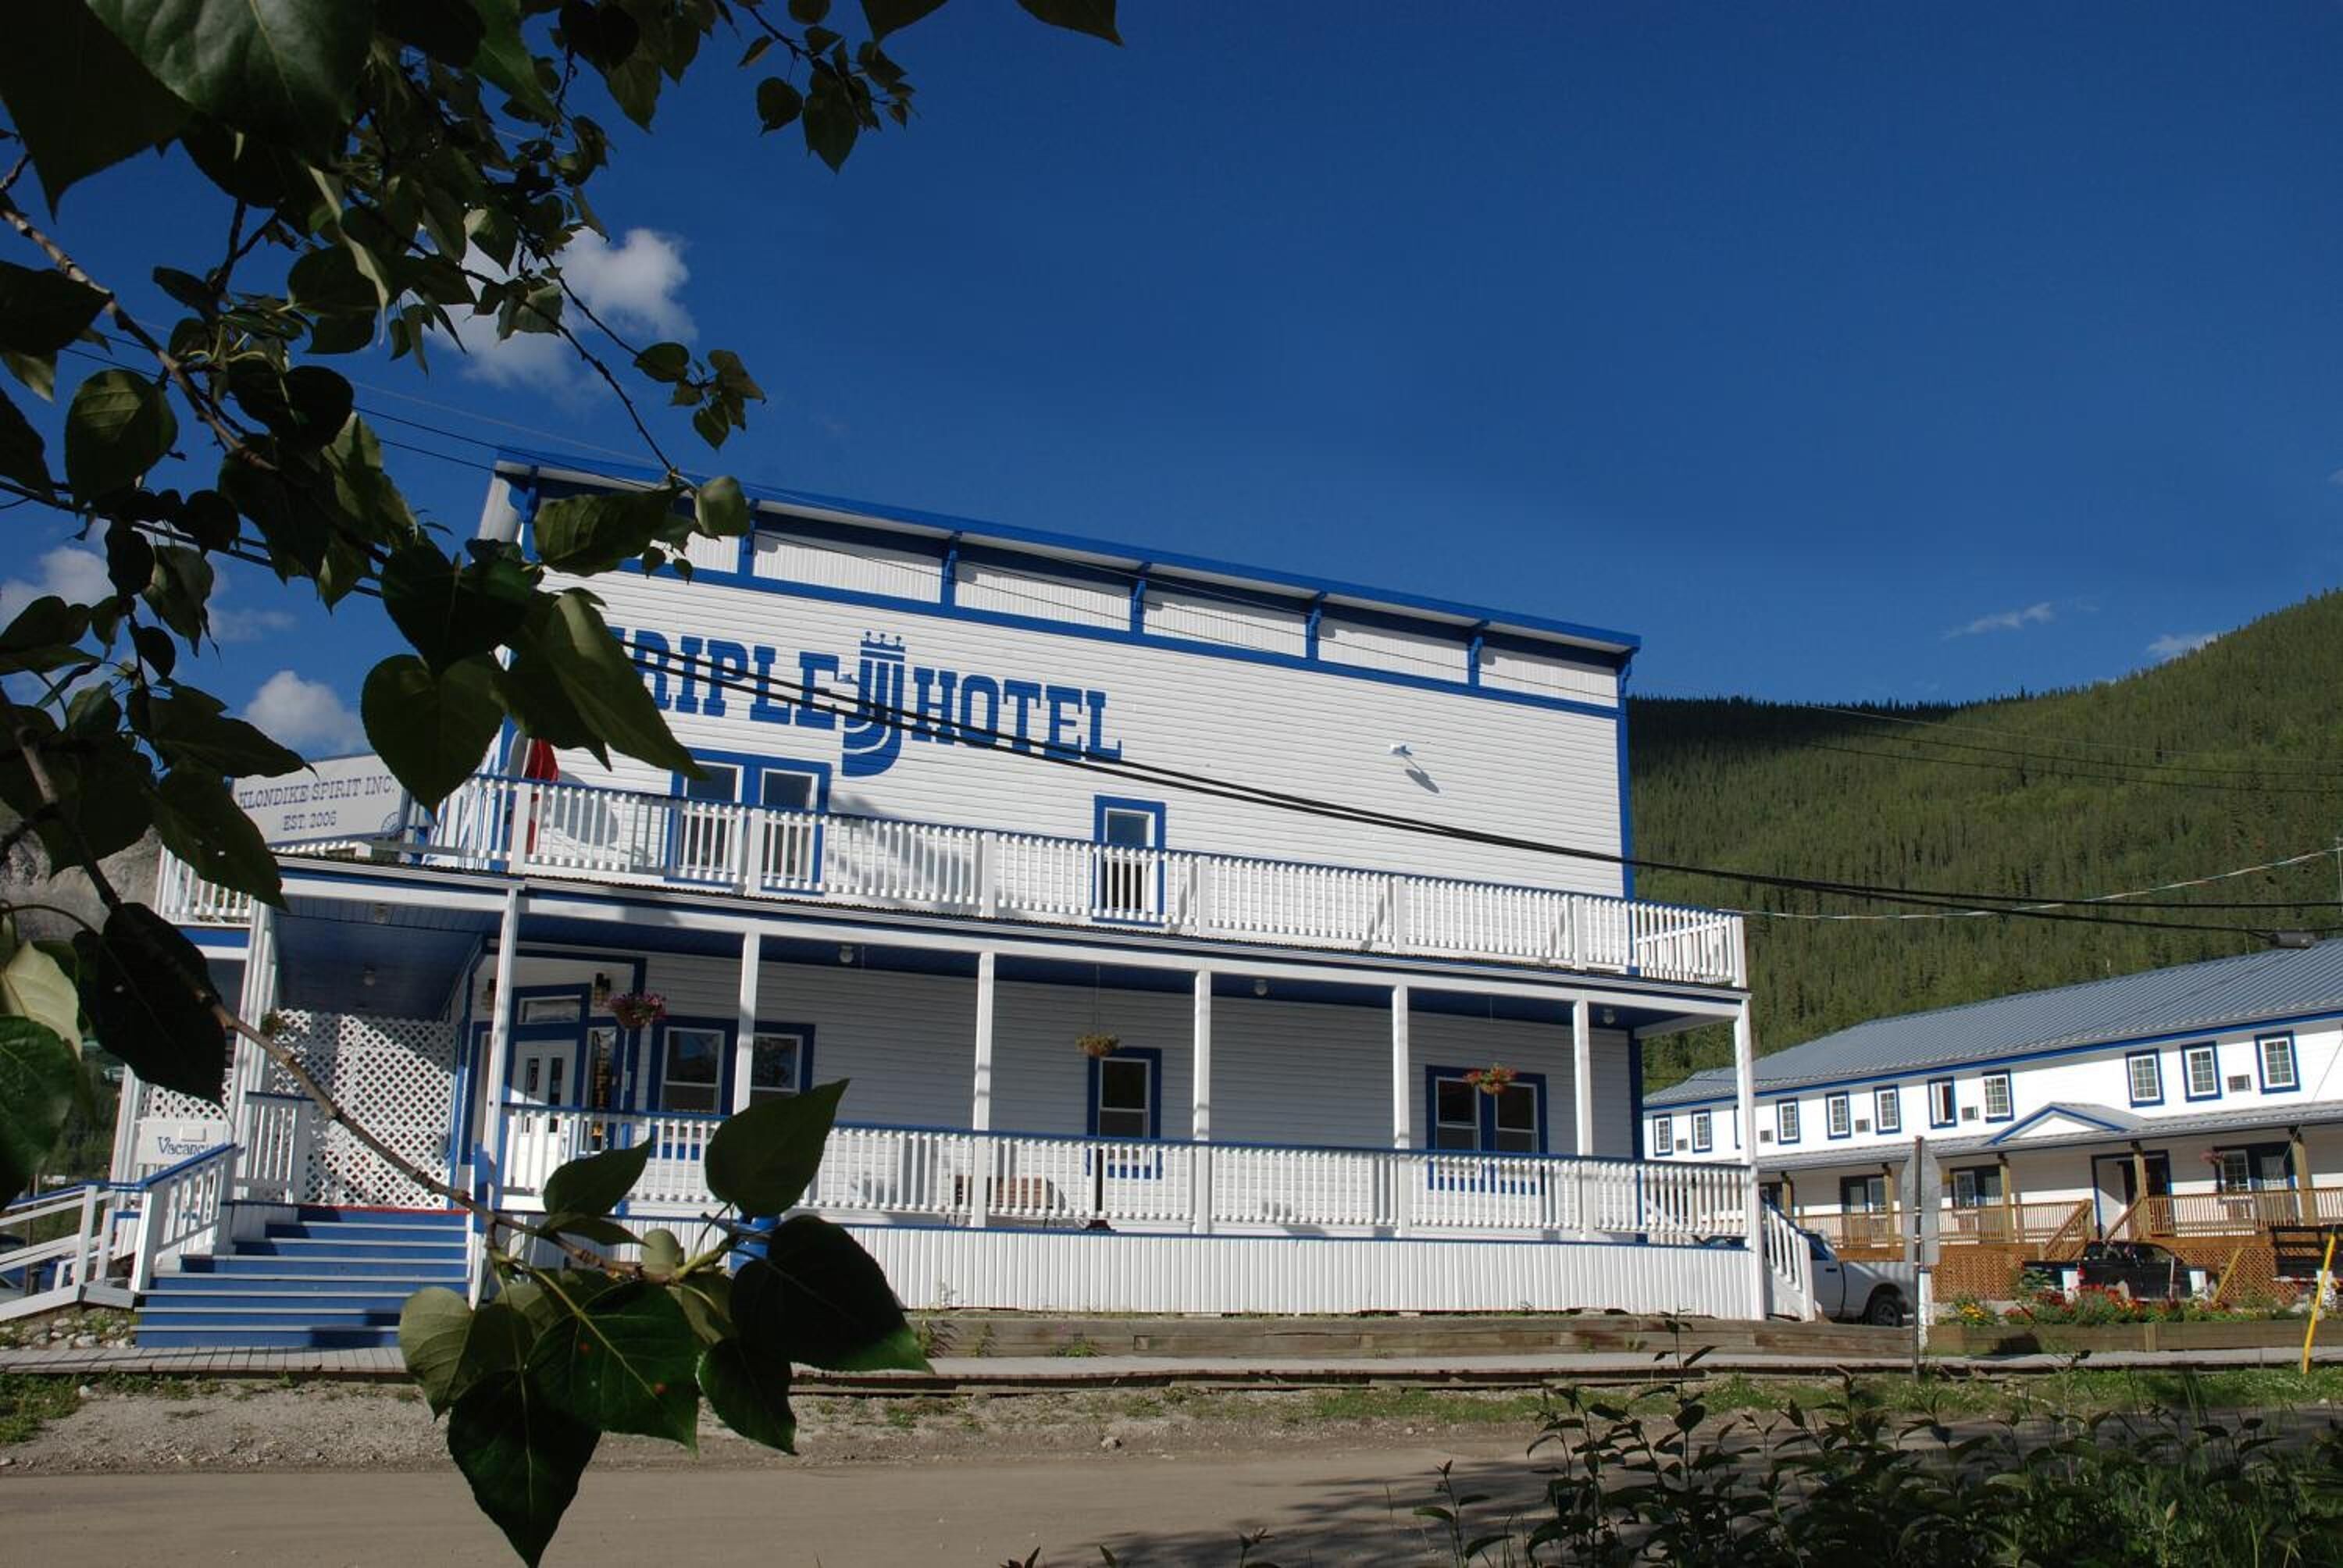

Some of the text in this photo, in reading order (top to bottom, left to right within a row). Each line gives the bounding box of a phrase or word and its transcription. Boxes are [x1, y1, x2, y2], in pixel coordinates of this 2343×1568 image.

[608, 625, 840, 730] RIPLE
[911, 665, 1123, 761] HOTEL
[312, 778, 362, 800] SPIRIT
[364, 775, 395, 796] INC.
[157, 1136, 208, 1155] Vacanc
